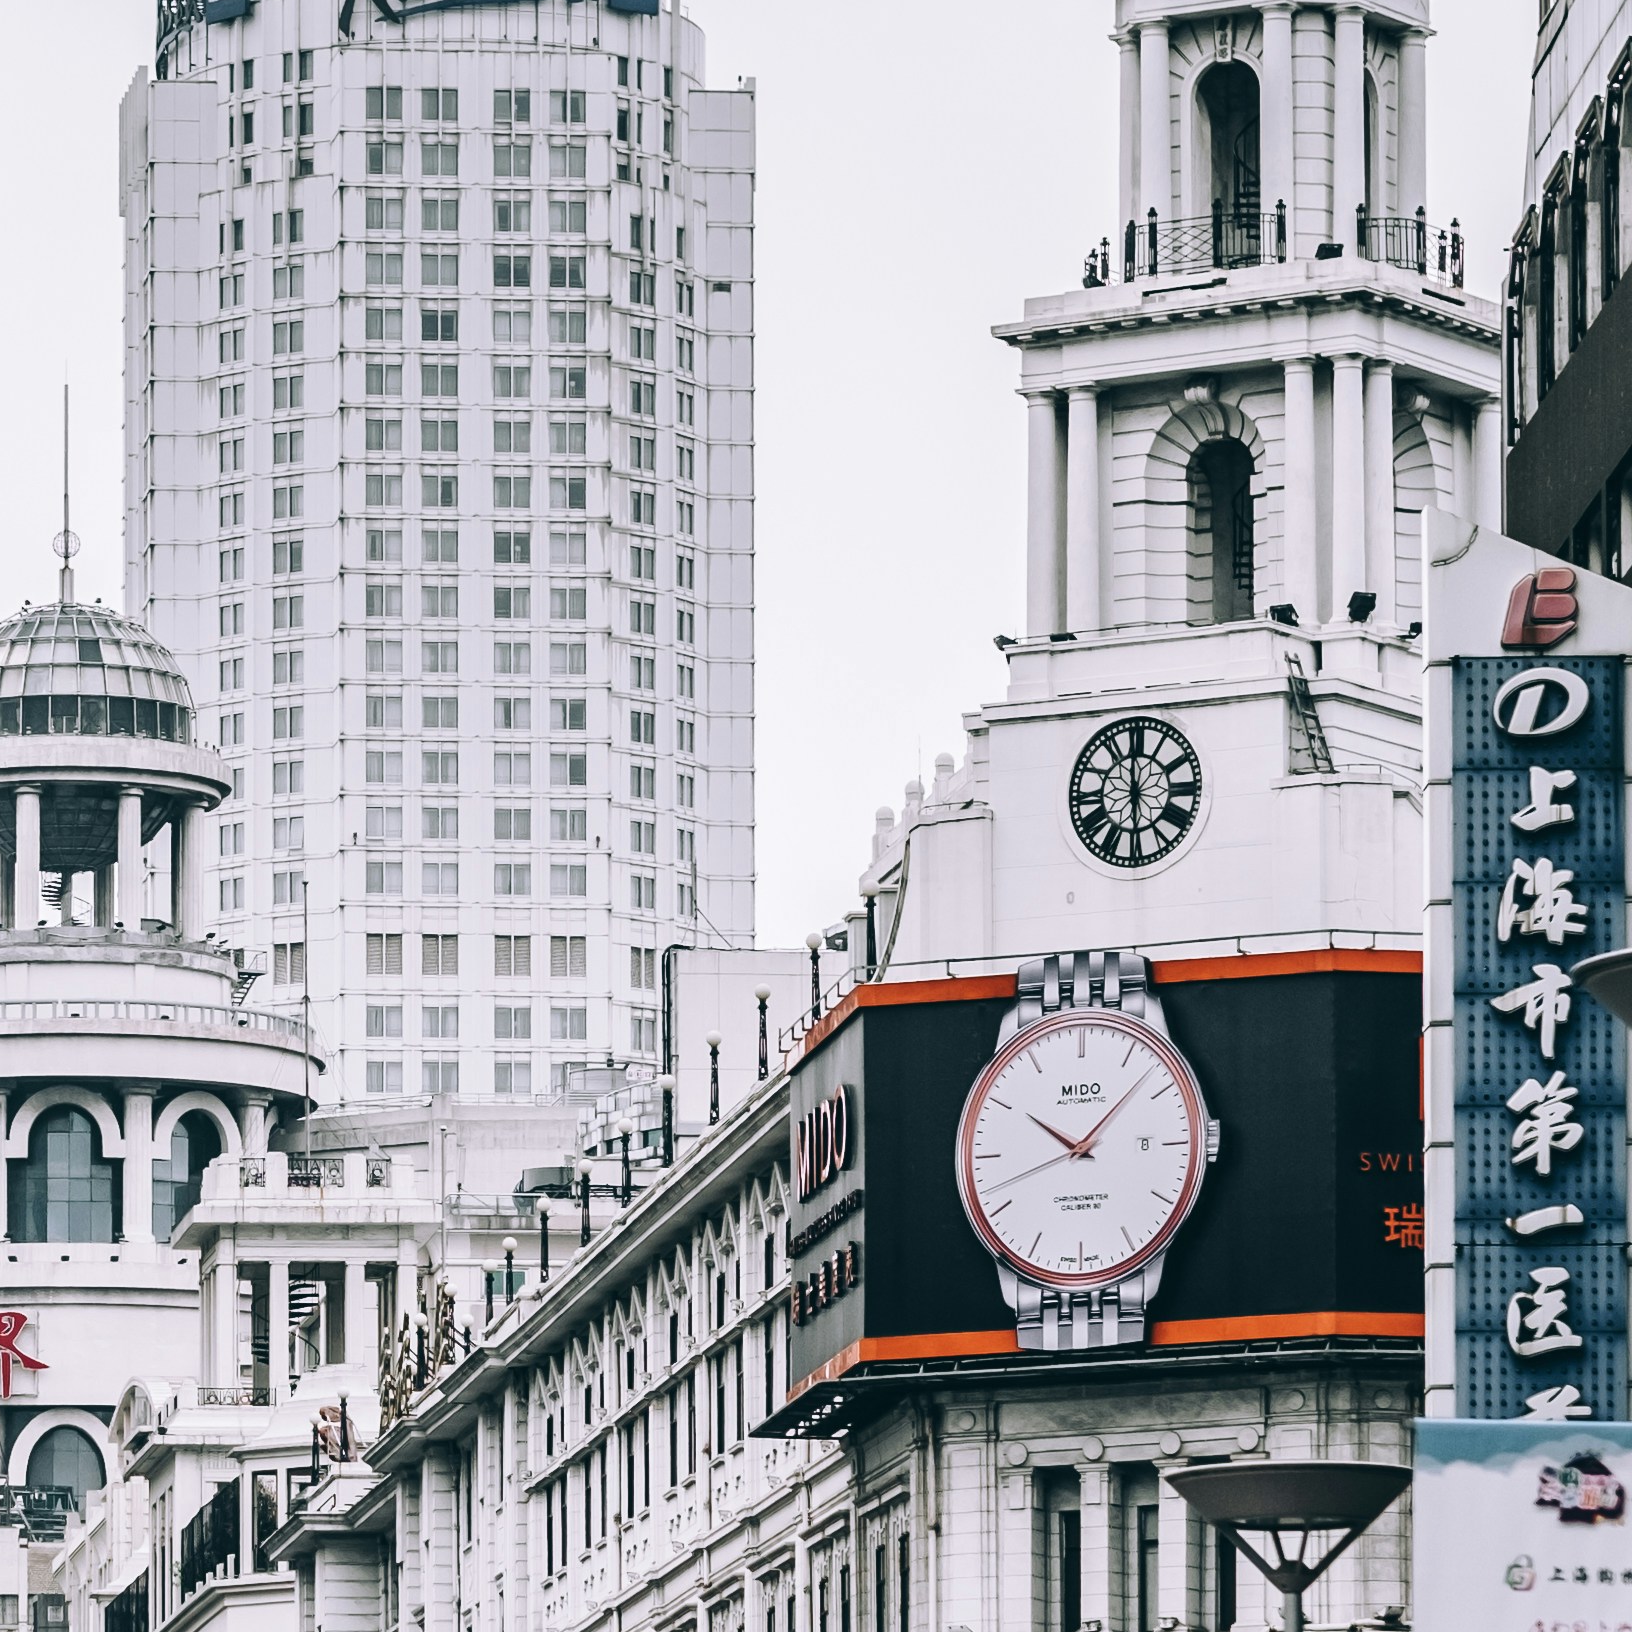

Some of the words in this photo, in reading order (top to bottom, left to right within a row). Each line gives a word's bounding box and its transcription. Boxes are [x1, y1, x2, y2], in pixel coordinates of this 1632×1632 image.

[1061, 1082, 1101, 1097] MIDO
[1056, 1096, 1107, 1105] AUTOMATIC
[797, 1083, 847, 1204] MIDO
[1360, 1152, 1424, 1172] SWI
